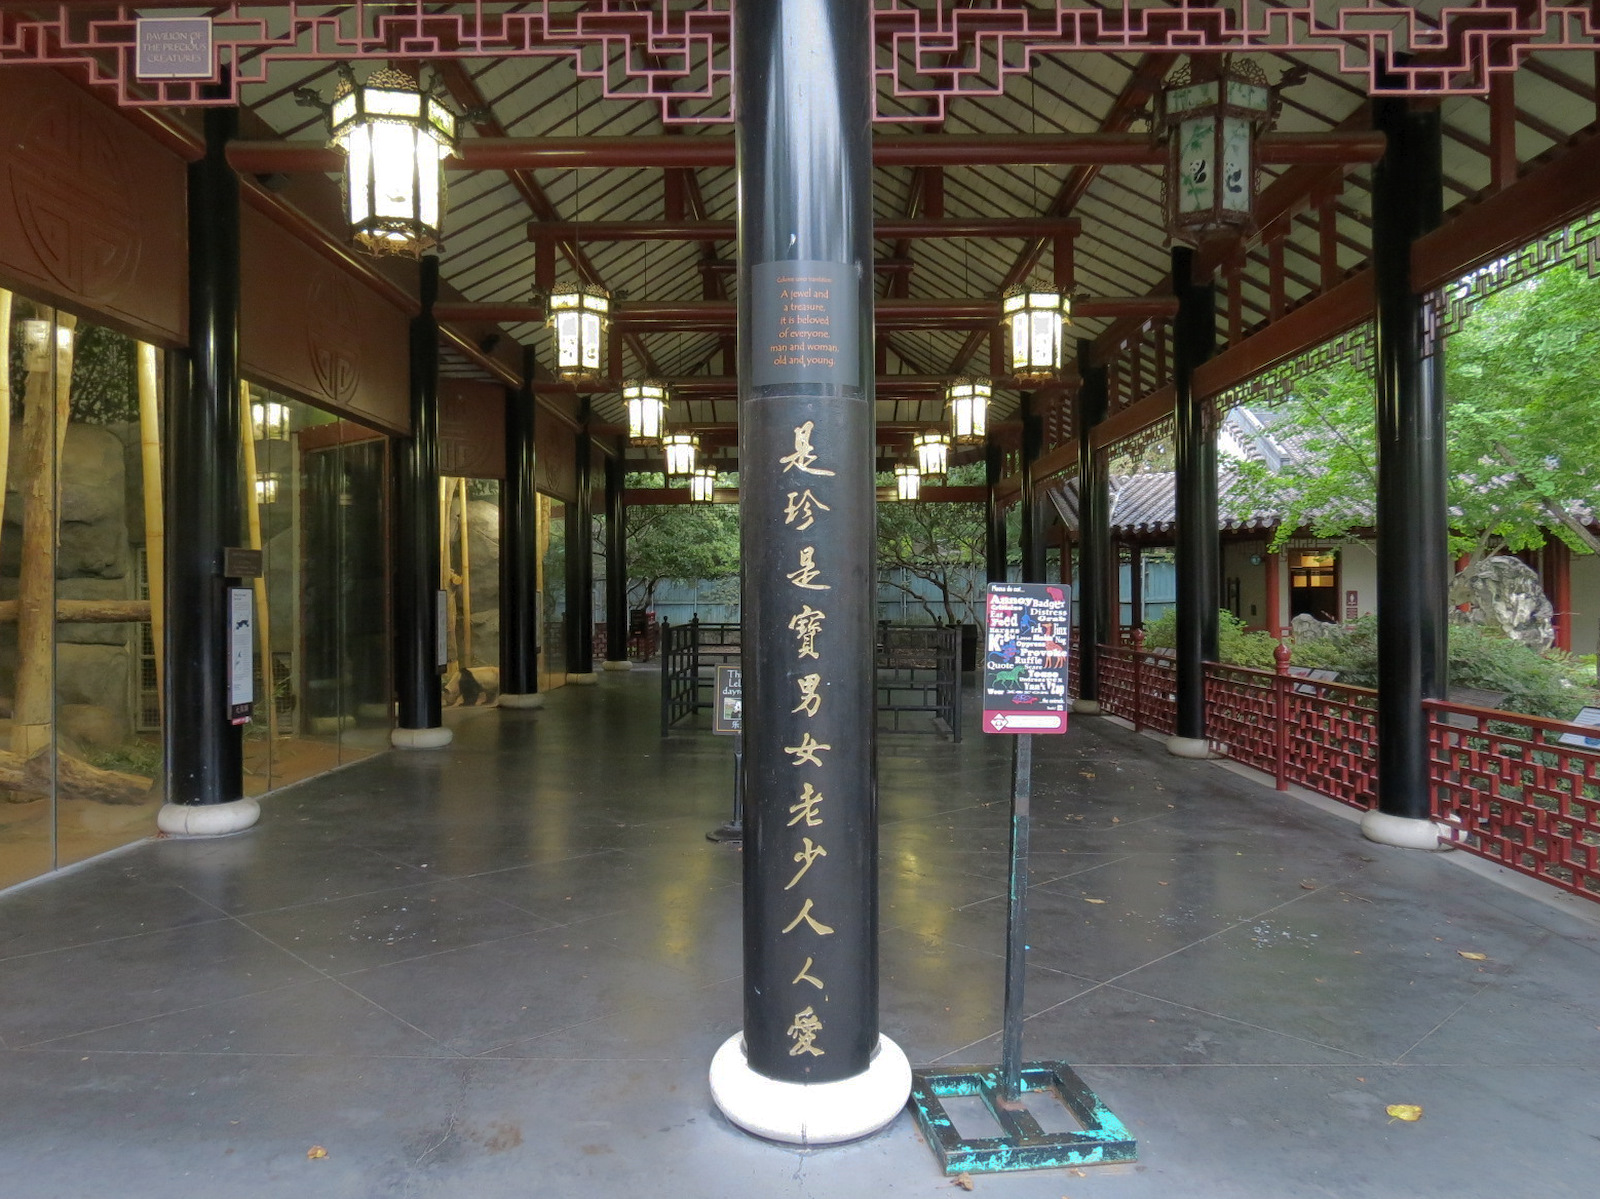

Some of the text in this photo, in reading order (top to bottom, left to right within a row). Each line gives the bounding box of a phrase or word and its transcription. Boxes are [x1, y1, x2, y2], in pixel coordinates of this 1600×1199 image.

[146, 31, 203, 41] PAVILION OF
[143, 42, 207, 51] THE PRECIOUS
[147, 53, 202, 63] CREATURES
[780, 287, 829, 300] A jewel and
[780, 314, 830, 325] it is beloved
[778, 326, 791, 338] of
[770, 344, 787, 352] man
[789, 341, 805, 351] and
[773, 355, 787, 365] old
[788, 355, 804, 364] and
[990, 594, 1034, 606] Annoy
[1032, 599, 1065, 609] Badger
[1030, 608, 1067, 616] Distress
[990, 613, 1019, 627] Feed
[1030, 622, 1043, 633] Irk
[1020, 648, 1068, 657] Provoke
[987, 660, 1015, 670] Quote
[1015, 656, 1043, 664] Ruffle
[727, 669, 742, 678] Th
